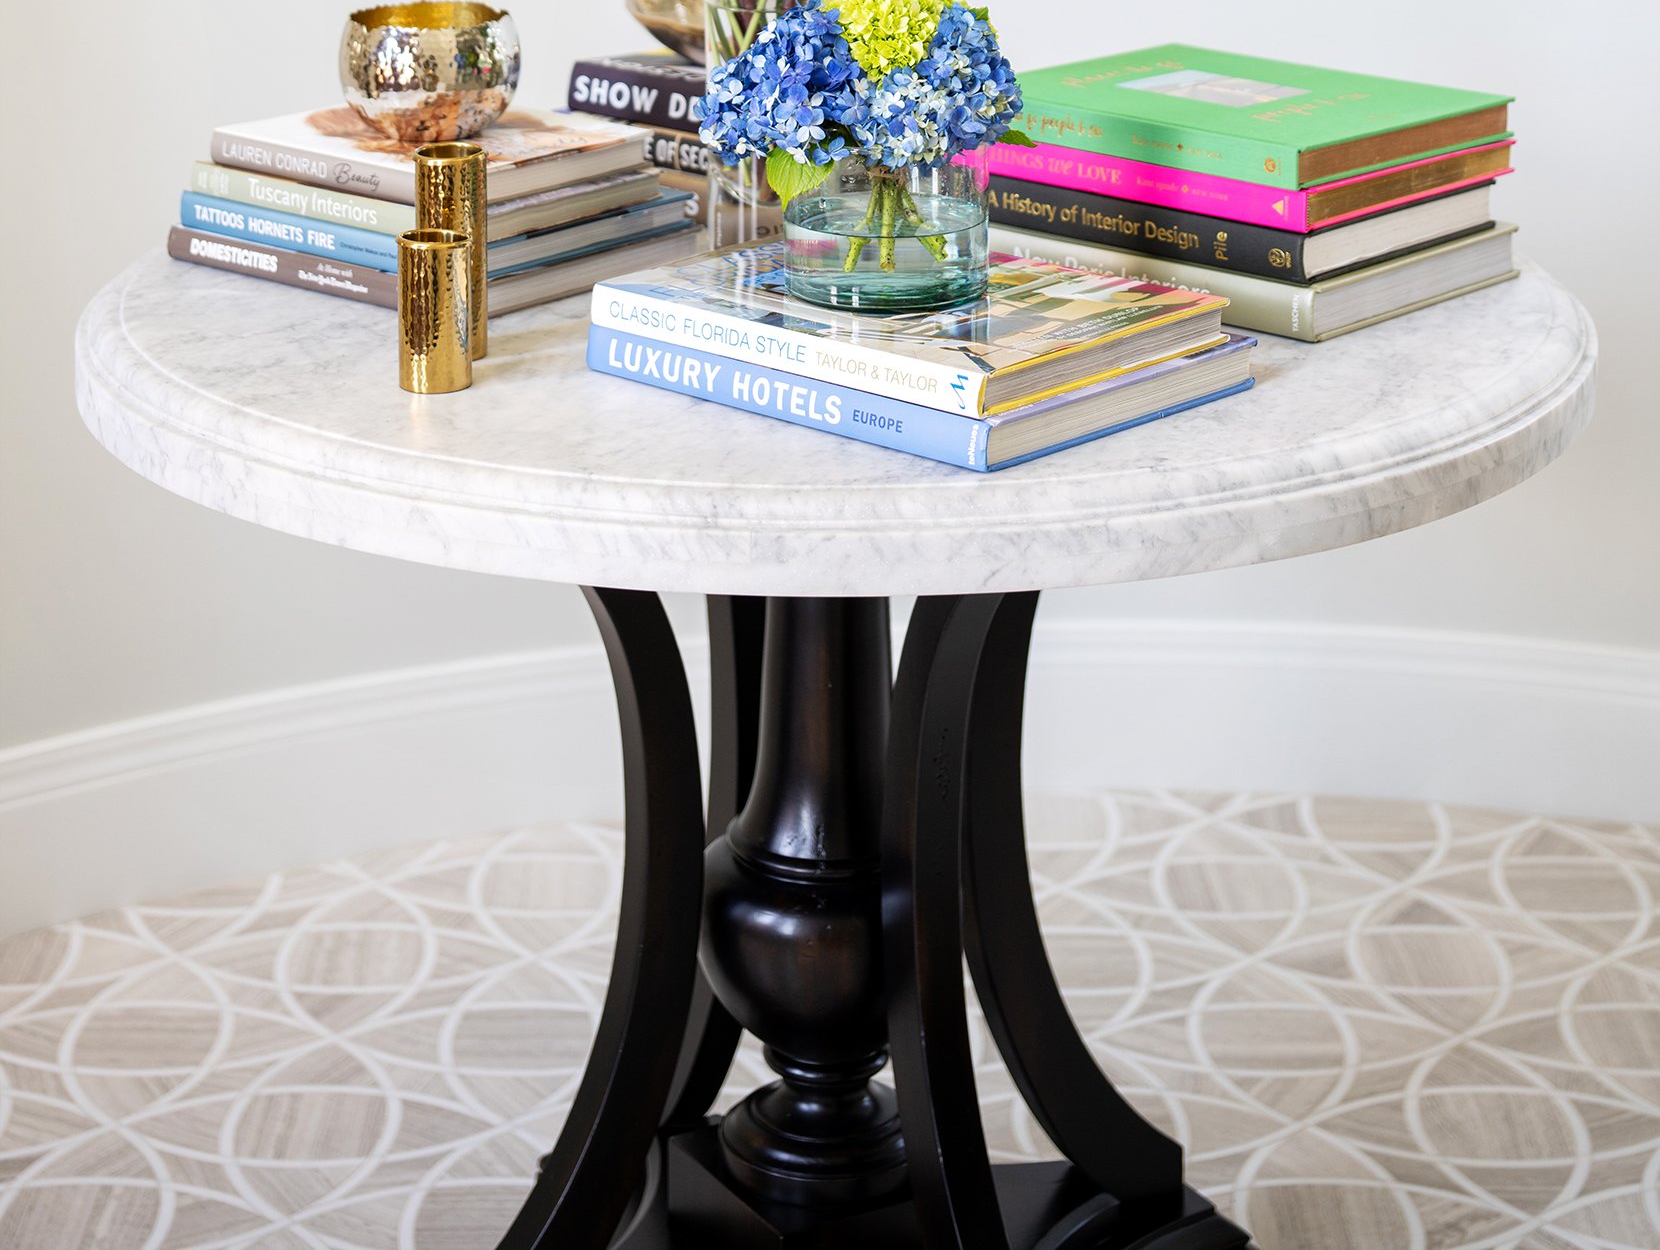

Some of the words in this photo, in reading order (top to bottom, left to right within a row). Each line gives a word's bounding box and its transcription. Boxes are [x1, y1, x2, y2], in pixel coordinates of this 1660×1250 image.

[573, 75, 658, 114] SHOW
[222, 141, 272, 166] LAUREN
[275, 153, 328, 178] CONRAD
[333, 162, 381, 192] Beauty
[1077, 163, 1122, 184] LOVE
[247, 177, 309, 216] Tuscany
[311, 191, 378, 225] Interiors
[988, 190, 999, 208] A
[1002, 191, 1057, 223] History
[1060, 204, 1079, 222] of
[1081, 207, 1141, 236] Interior
[1144, 220, 1200, 250] Design
[193, 204, 245, 230] TATTOOS
[248, 216, 304, 243] HORNETS
[307, 229, 336, 251] FIRE
[1213, 231, 1229, 261] Pile
[189, 238, 279, 273] DOMESTICITIES
[1291, 294, 1301, 332] TASCHEN
[609, 300, 677, 332] CLASSIC
[683, 318, 751, 350] FLORIDA
[755, 335, 808, 364] STYLE
[815, 352, 868, 377] TAYLOR
[871, 364, 881, 380] &
[884, 367, 939, 394] TAYLOR
[608, 338, 722, 393] LUXURY
[732, 370, 843, 426] HOTELS
[852, 409, 904, 434] EUROPE
